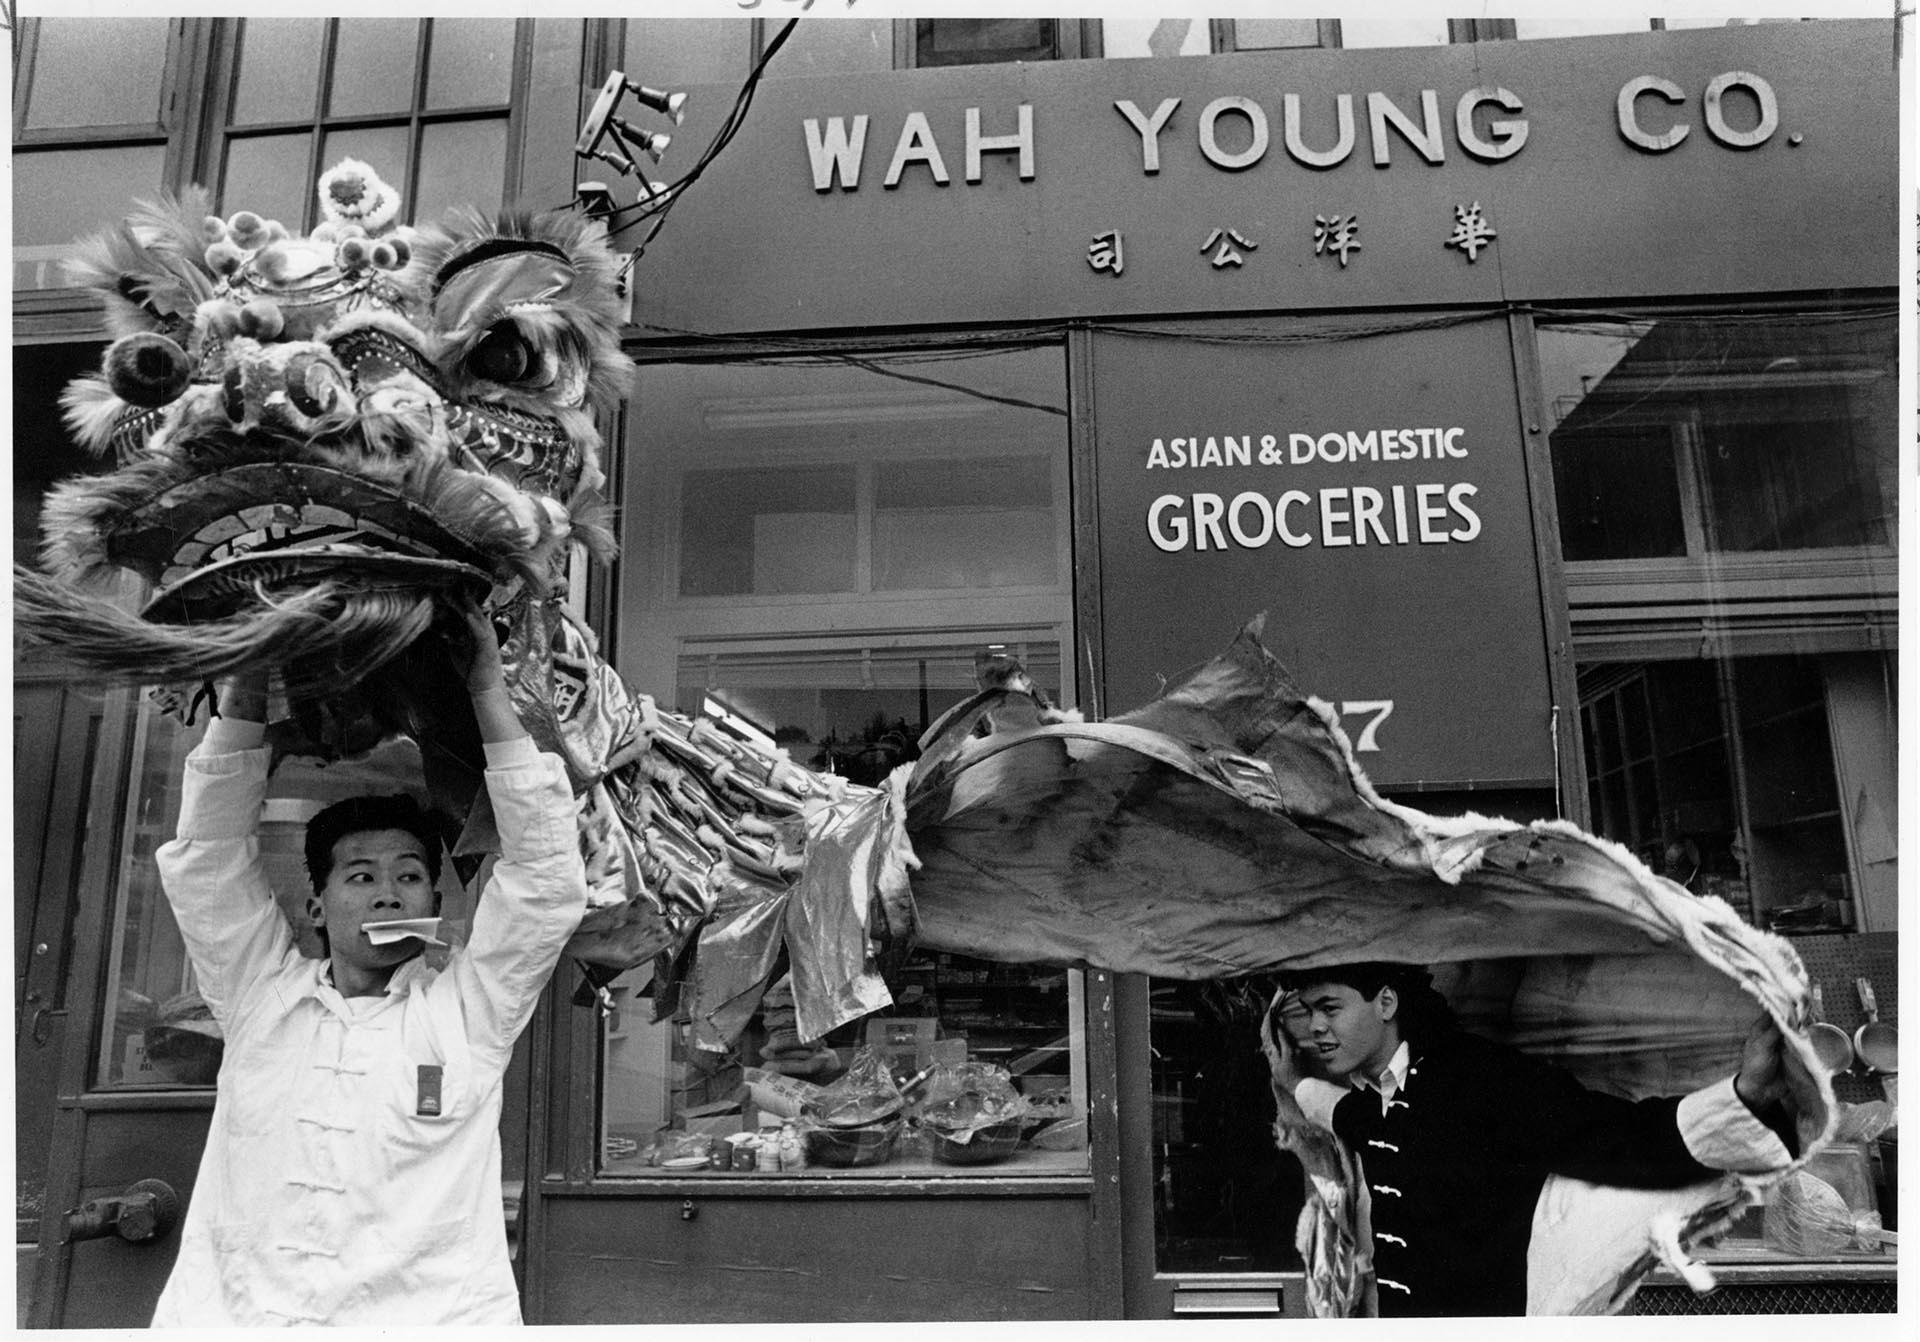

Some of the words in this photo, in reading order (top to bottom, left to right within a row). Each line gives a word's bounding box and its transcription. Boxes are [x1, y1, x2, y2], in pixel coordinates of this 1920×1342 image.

[803, 104, 1035, 192] WAH
[1113, 86, 1531, 176] YOUNG
[1616, 70, 1804, 154] CO.
[1146, 435, 1252, 469] ASIAN
[1257, 434, 1283, 465] &
[1288, 427, 1469, 465] DOMESTIC
[1147, 482, 1482, 552] GROCERIES
